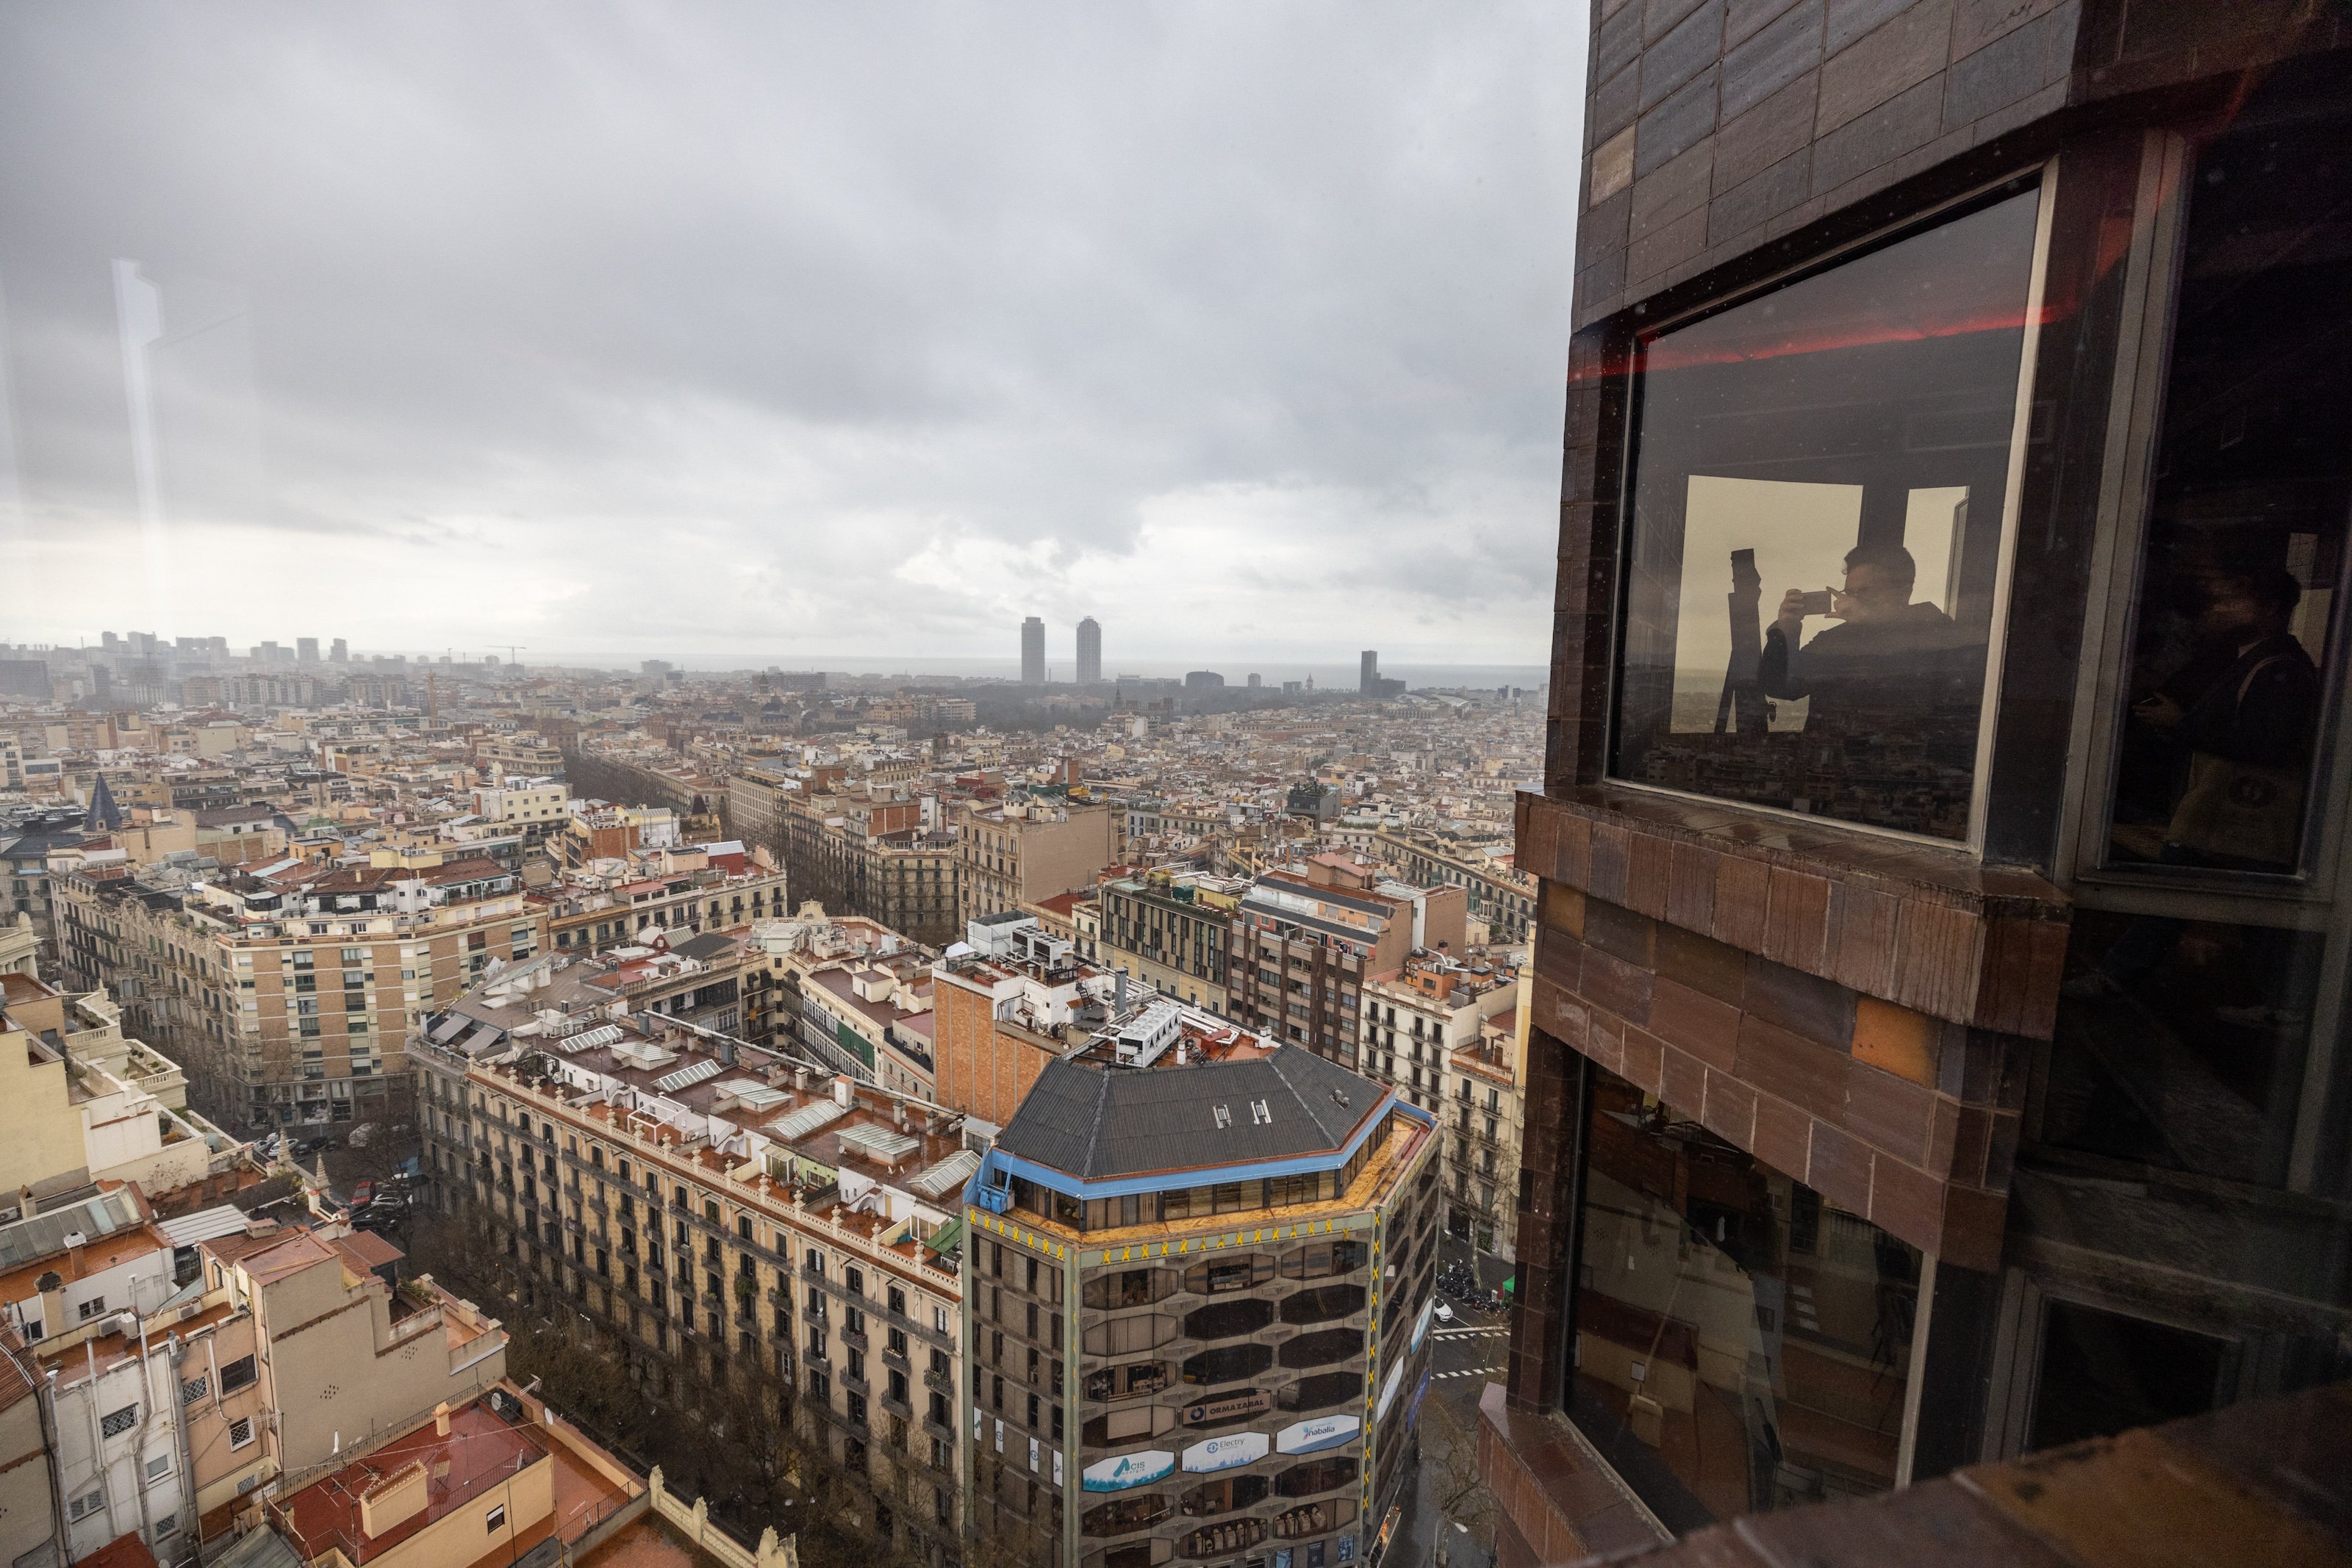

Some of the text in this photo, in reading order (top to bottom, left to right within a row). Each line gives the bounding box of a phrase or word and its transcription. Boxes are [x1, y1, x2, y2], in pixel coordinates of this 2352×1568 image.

[1210, 1400, 1263, 1414] ORMAZABAL
[1308, 1425, 1335, 1436] nabalia
[1220, 1439, 1244, 1448] Electry
